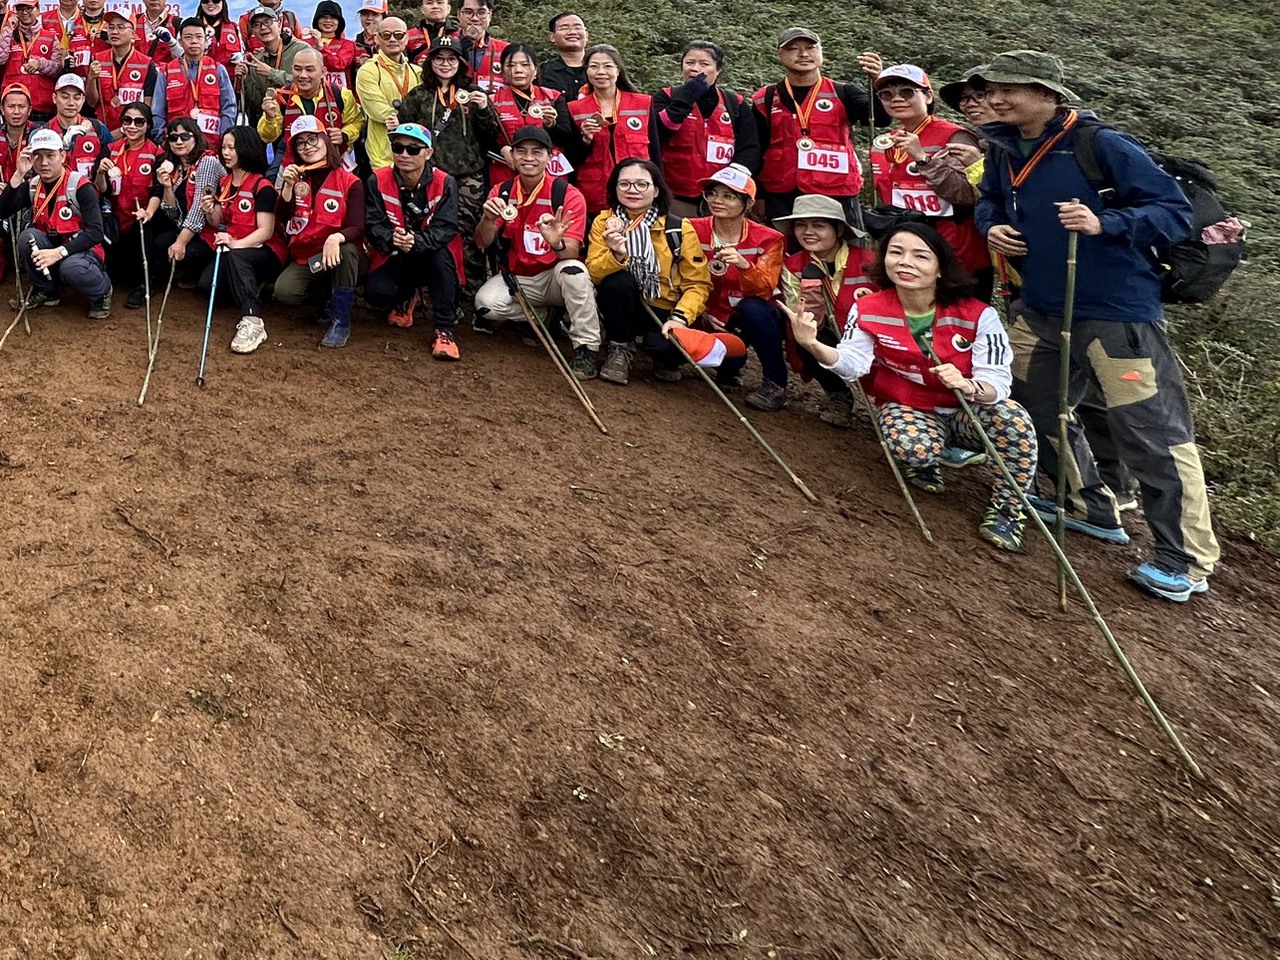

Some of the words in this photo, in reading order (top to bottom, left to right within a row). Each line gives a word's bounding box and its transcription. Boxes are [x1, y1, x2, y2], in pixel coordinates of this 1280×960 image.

[715, 145, 733, 161] 04
[806, 152, 840, 169] 045
[902, 193, 942, 212] 018
